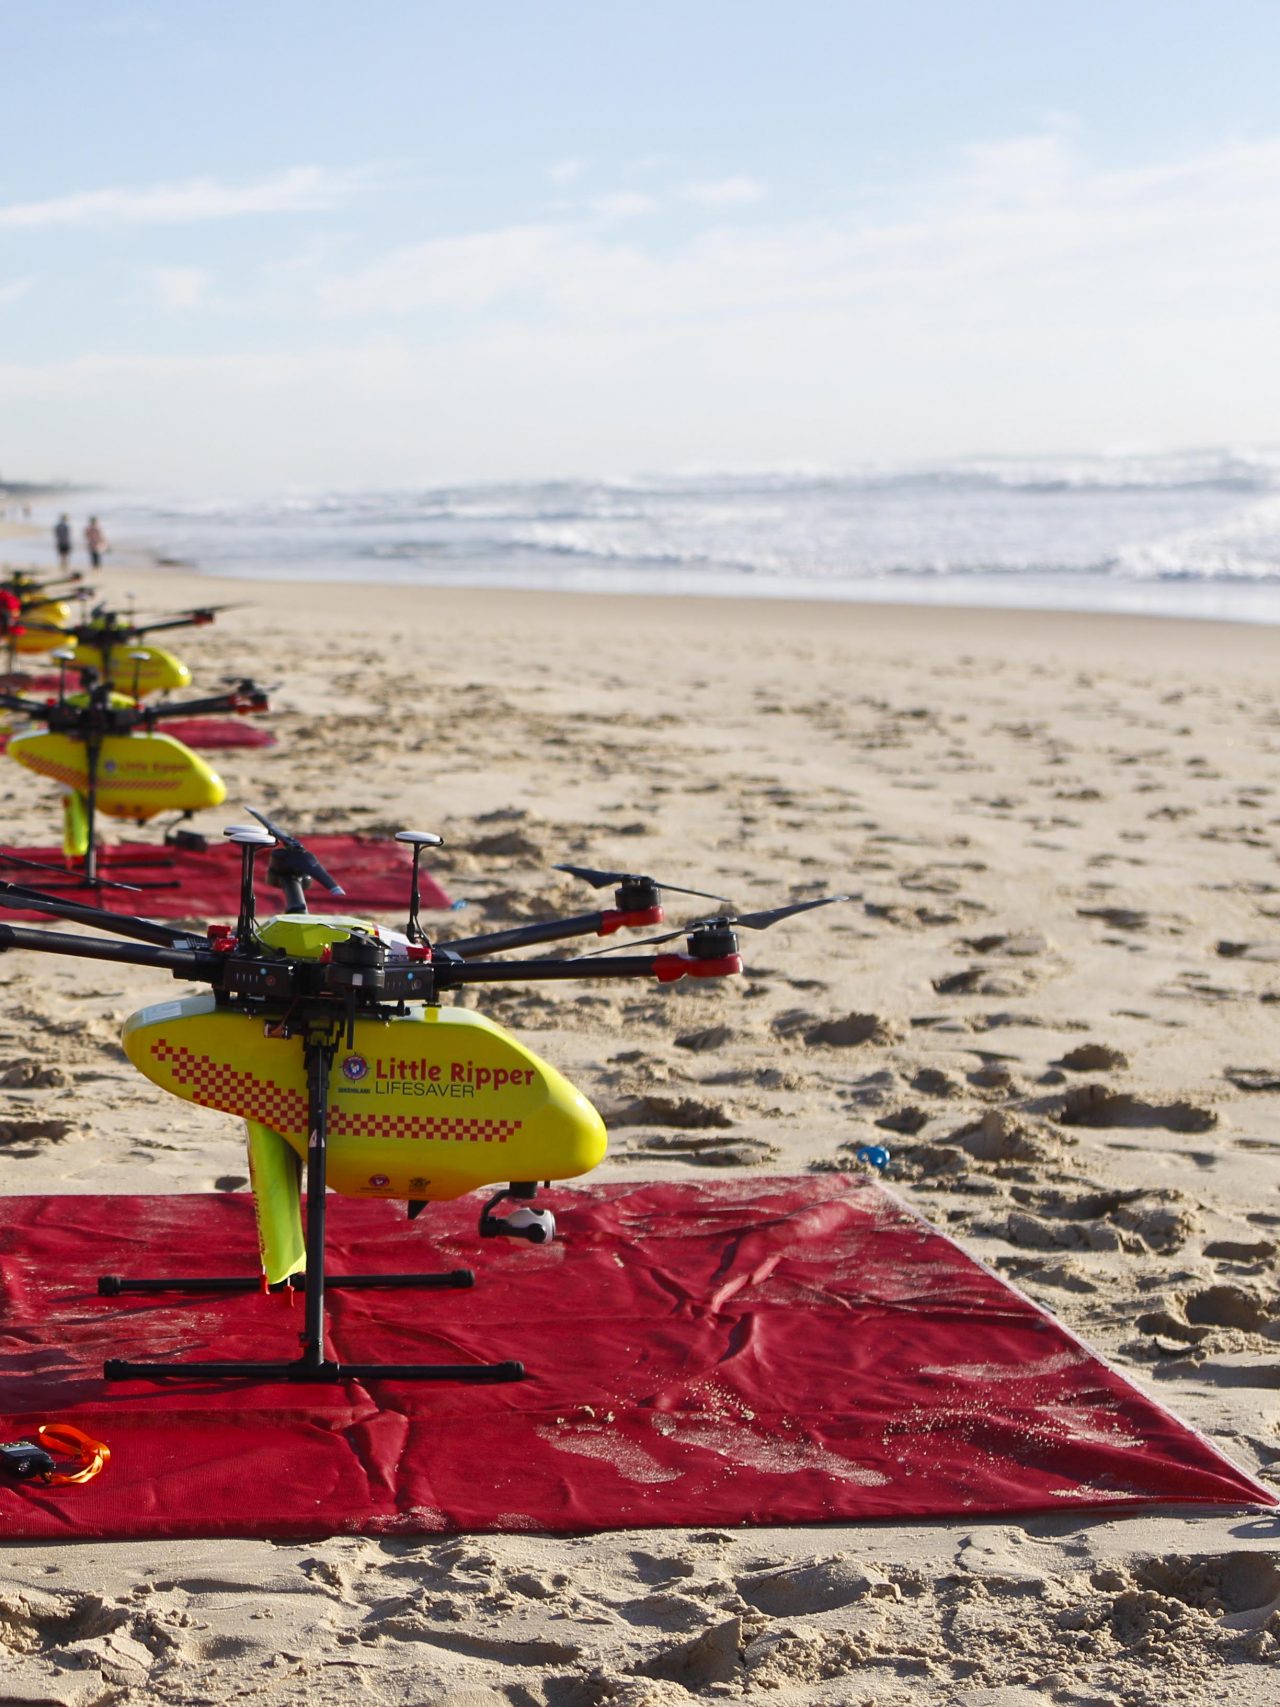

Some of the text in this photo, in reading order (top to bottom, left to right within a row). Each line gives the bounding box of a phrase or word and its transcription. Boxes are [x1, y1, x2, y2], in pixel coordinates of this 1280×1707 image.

[376, 1057, 441, 1081] Little
[450, 1060, 535, 1090] Ripper
[375, 1081, 474, 1098] LIFESAVER
